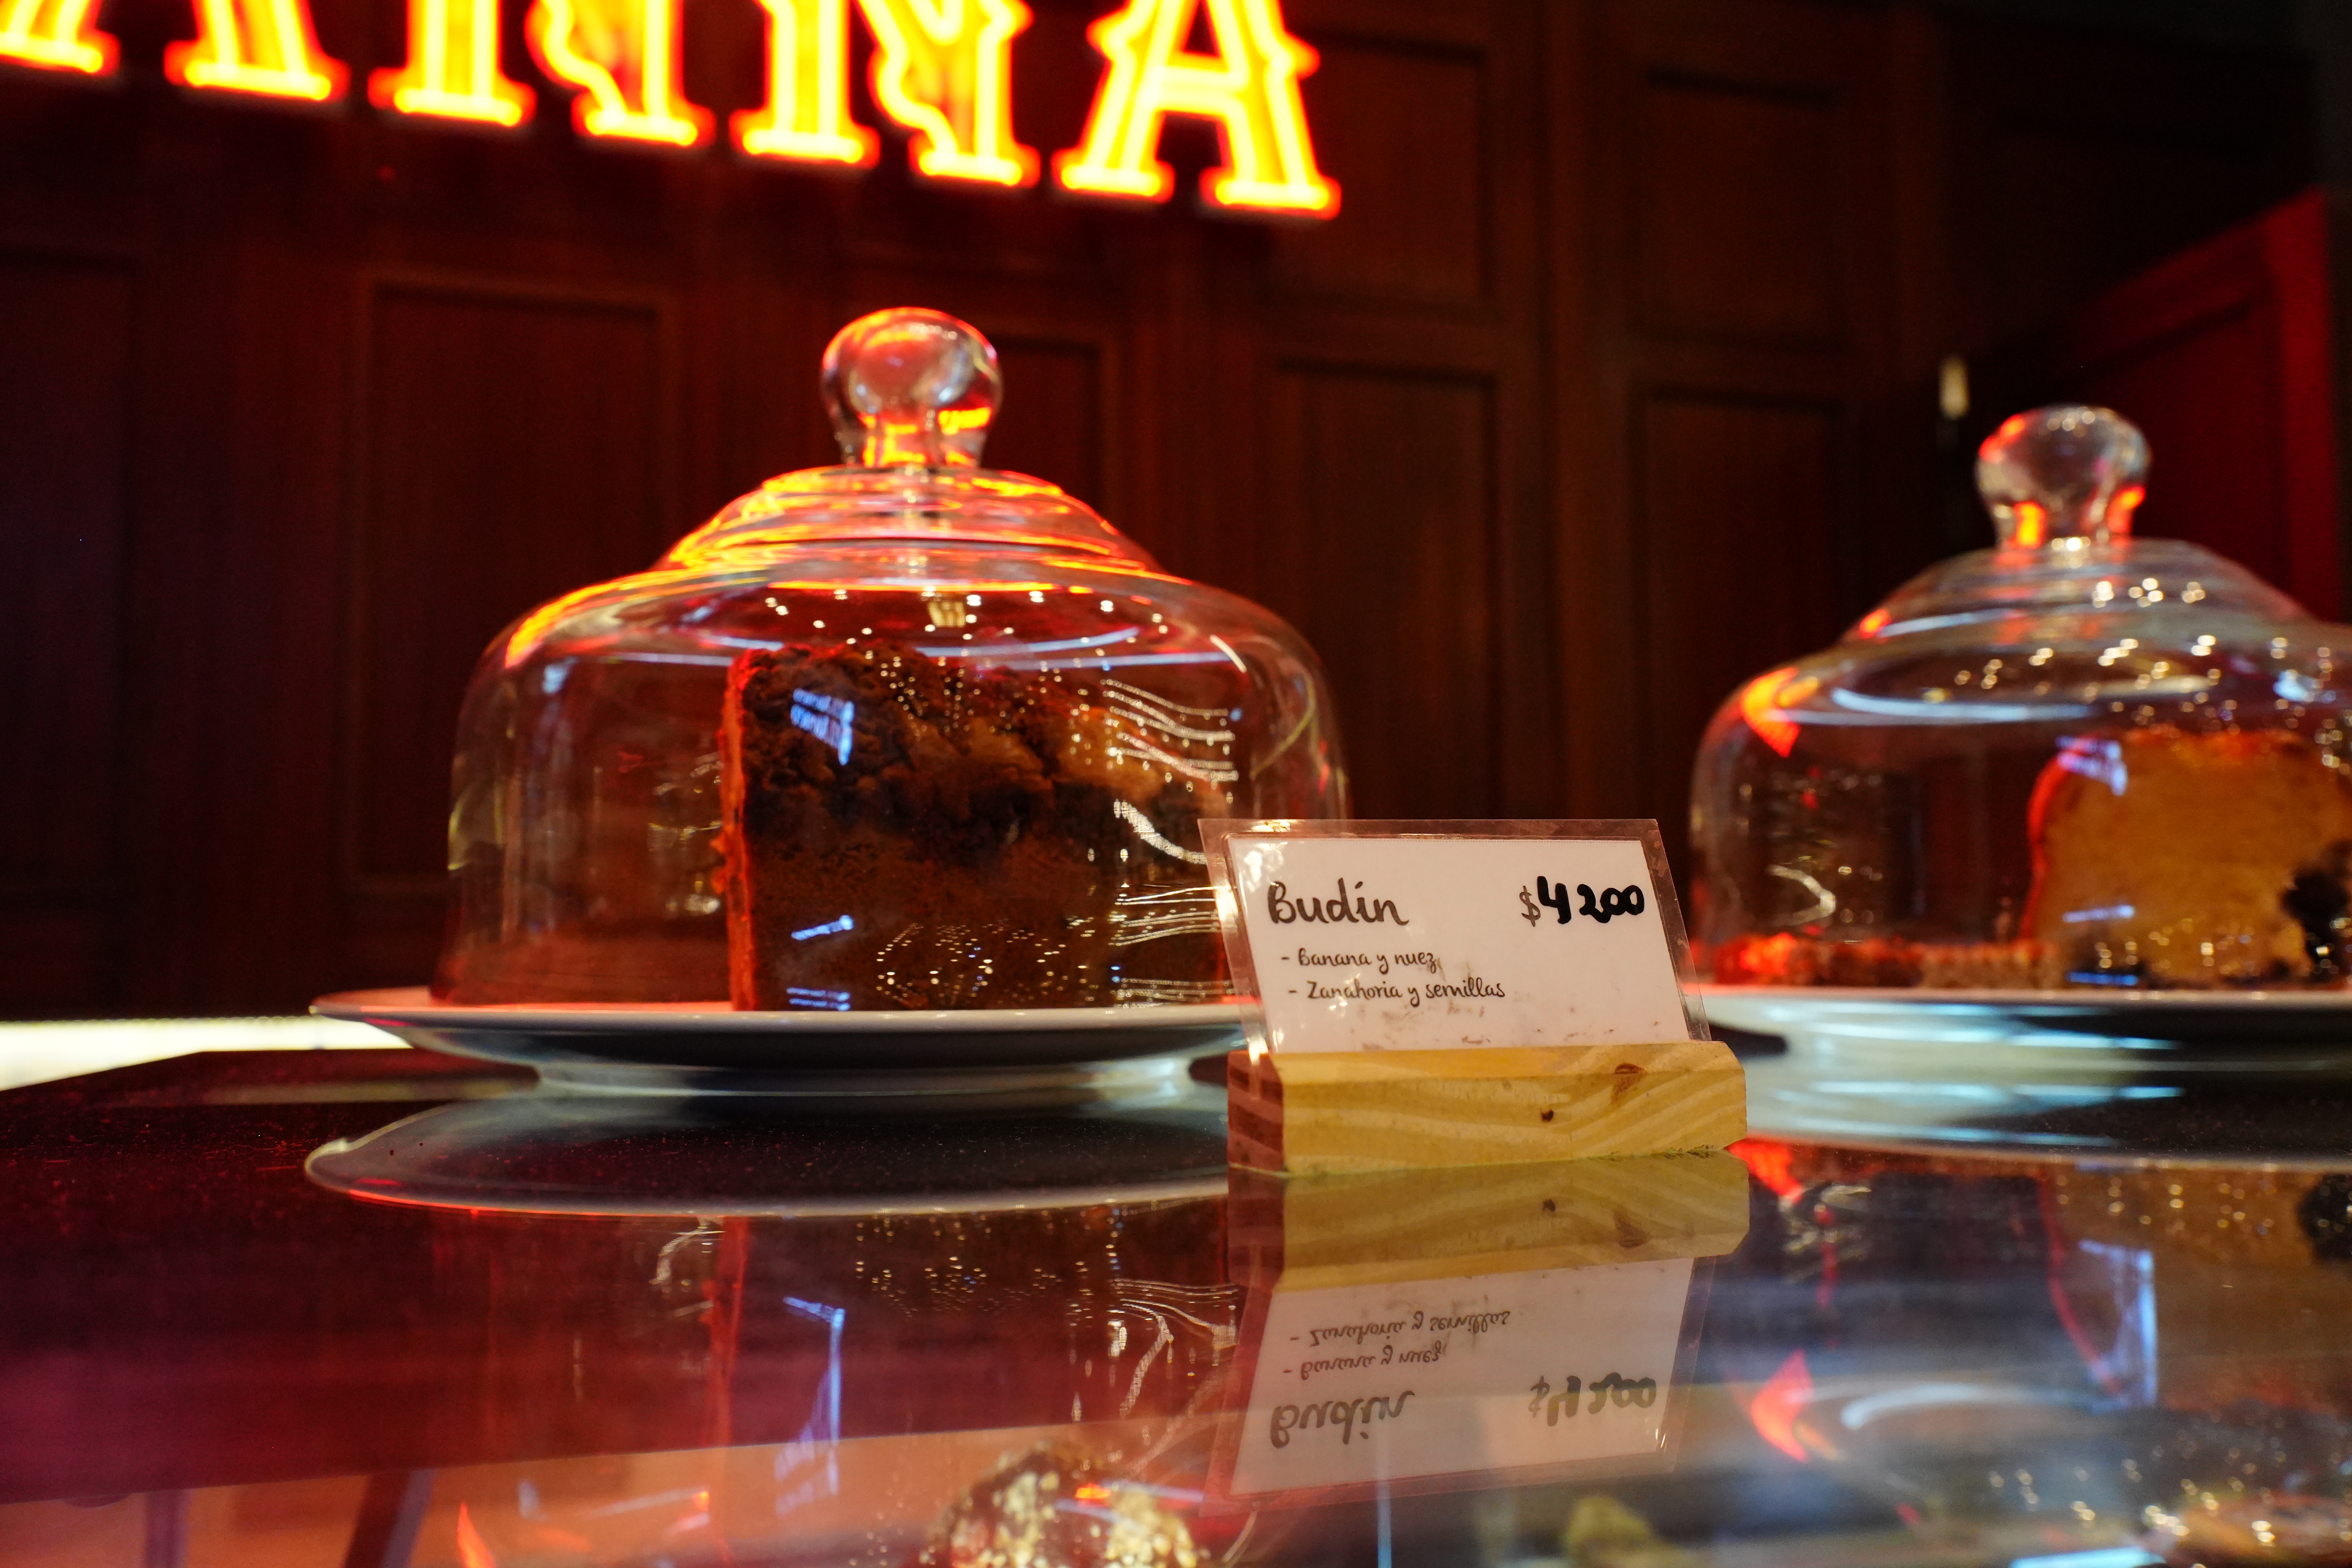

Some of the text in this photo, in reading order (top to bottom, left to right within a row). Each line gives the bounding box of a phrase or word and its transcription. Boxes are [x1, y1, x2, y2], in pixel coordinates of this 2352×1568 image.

[0, 0, 1341, 217] NA
[1267, 877, 1409, 926] Budín
[1298, 947, 1437, 975] Banana y nuez
[1306, 977, 1505, 1008] Zanahoria y semillas
